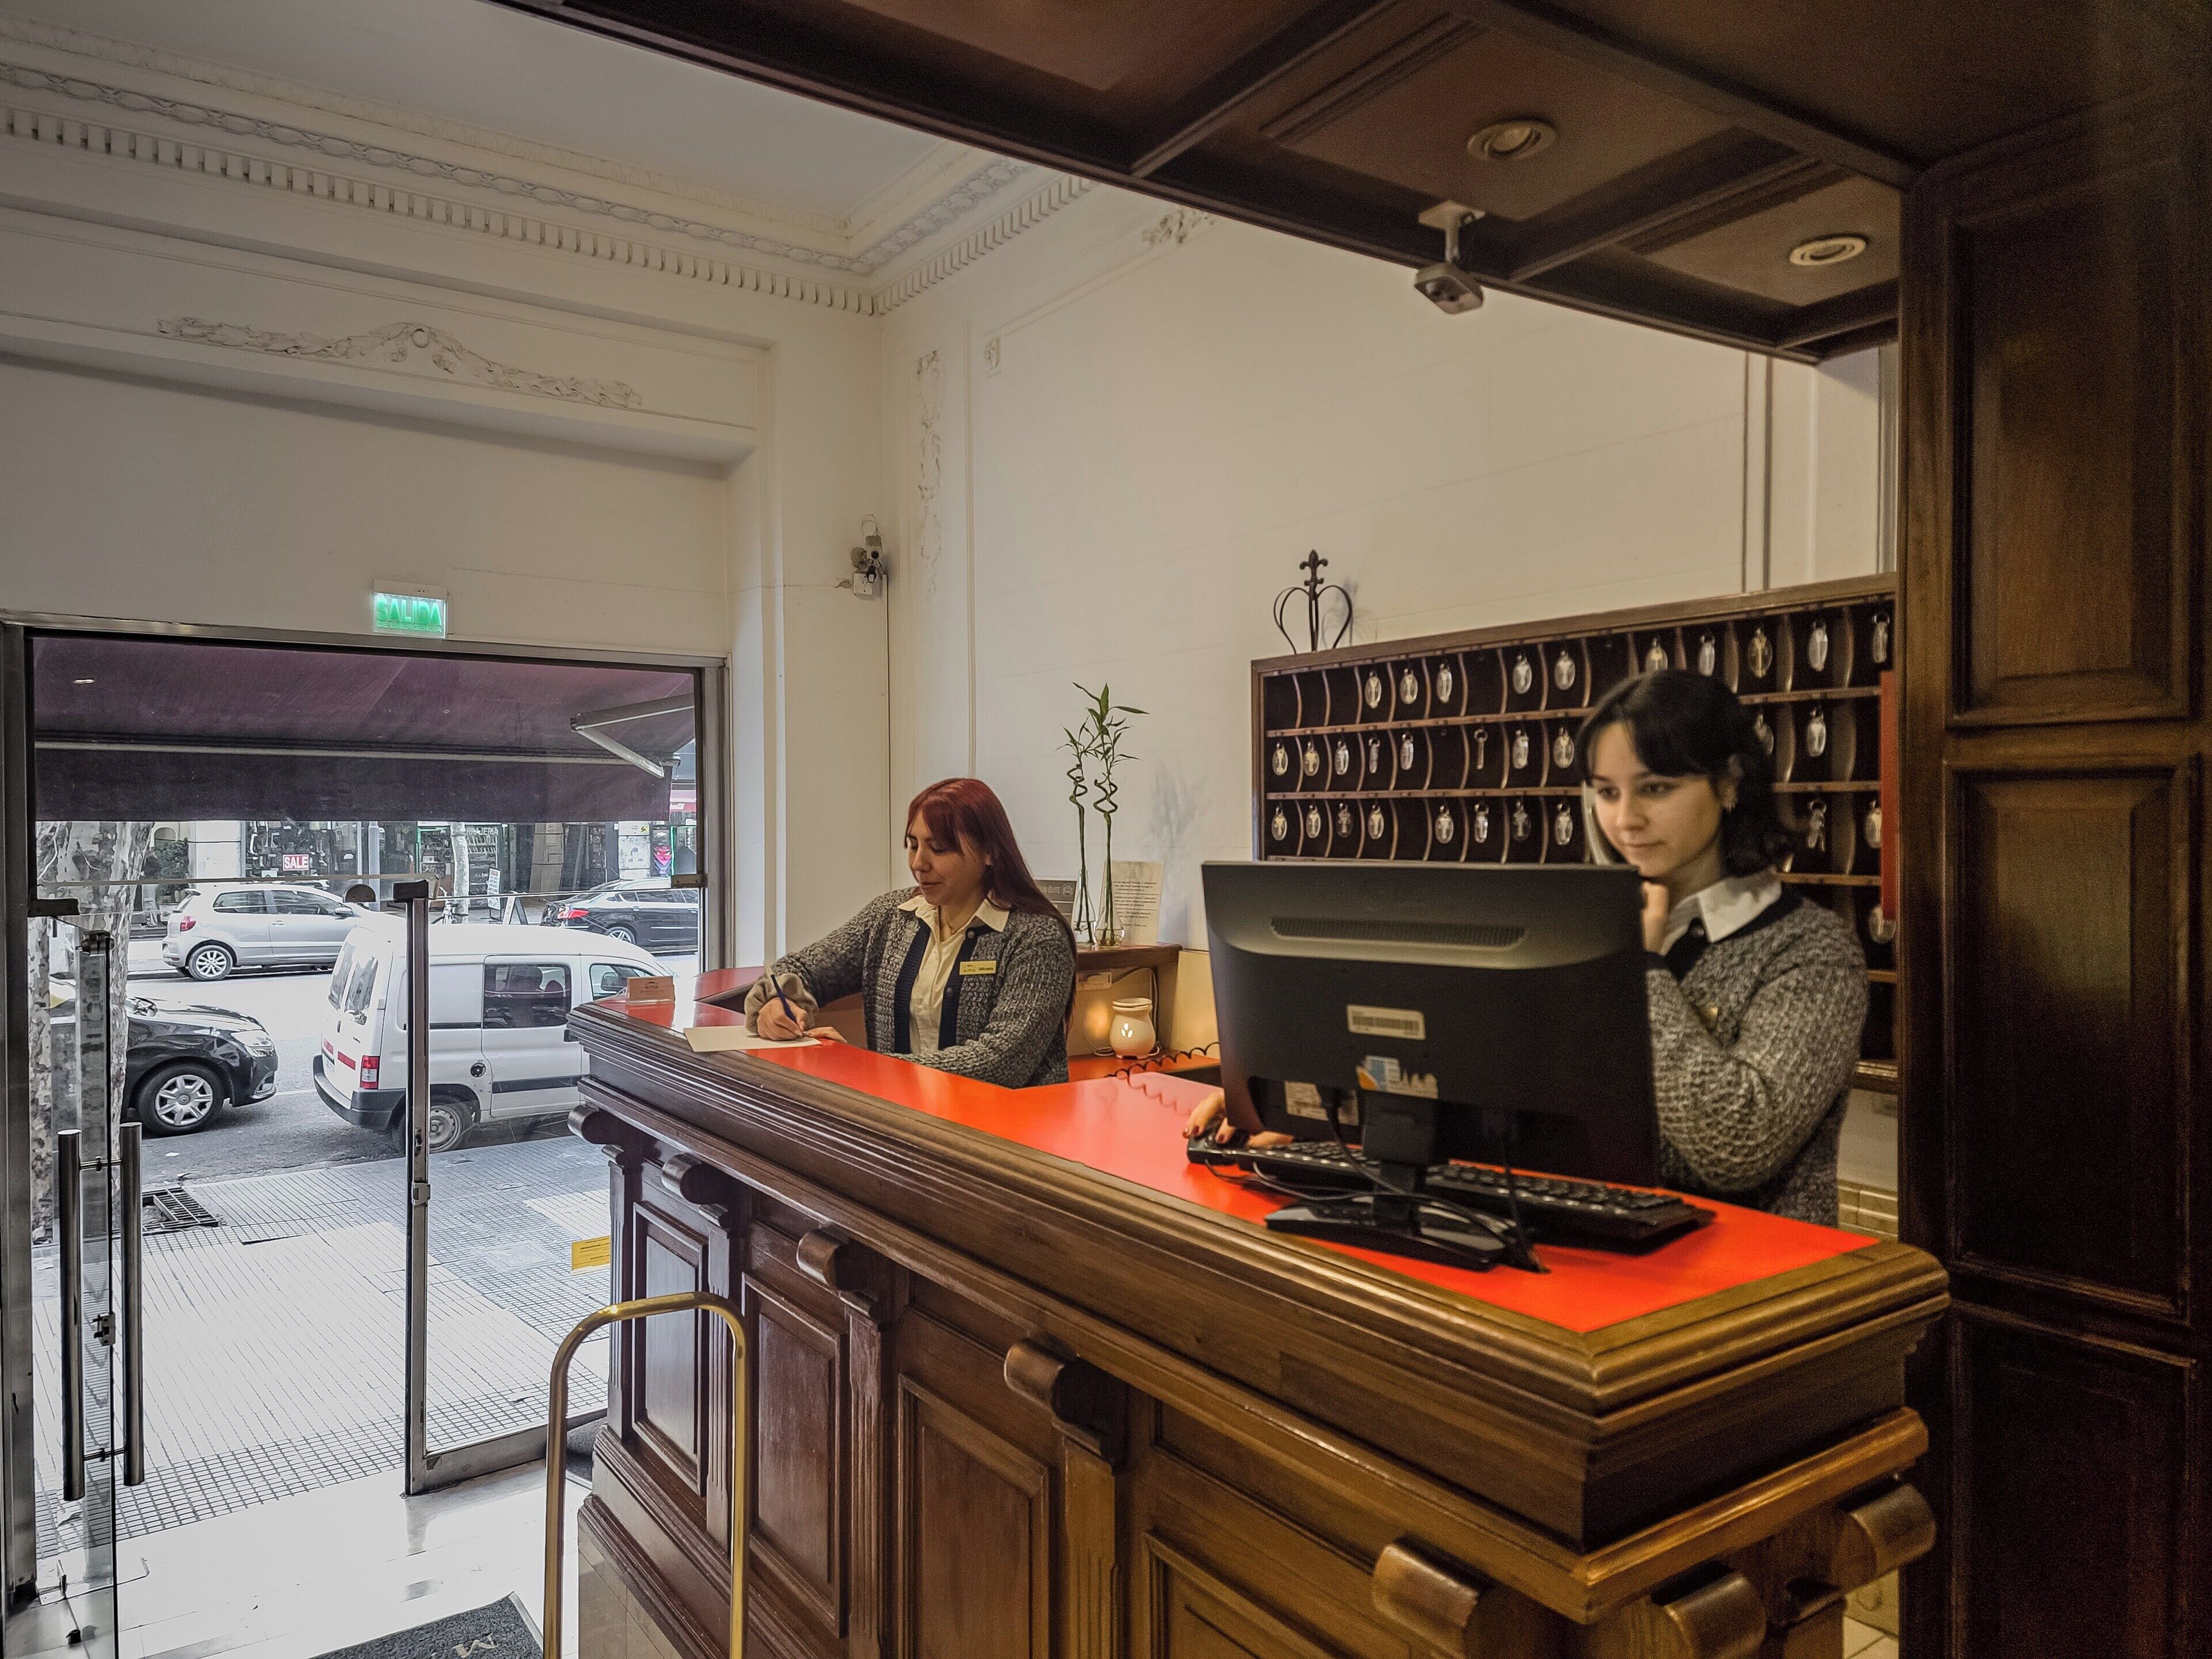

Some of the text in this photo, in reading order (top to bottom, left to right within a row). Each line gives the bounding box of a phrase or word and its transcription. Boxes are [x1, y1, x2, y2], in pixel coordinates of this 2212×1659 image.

[376, 595, 442, 626] SALIDA
[390, 622, 442, 632] EMERGENCIA
[466, 827, 499, 836] RRAJERIA
[285, 856, 308, 869] SALE
